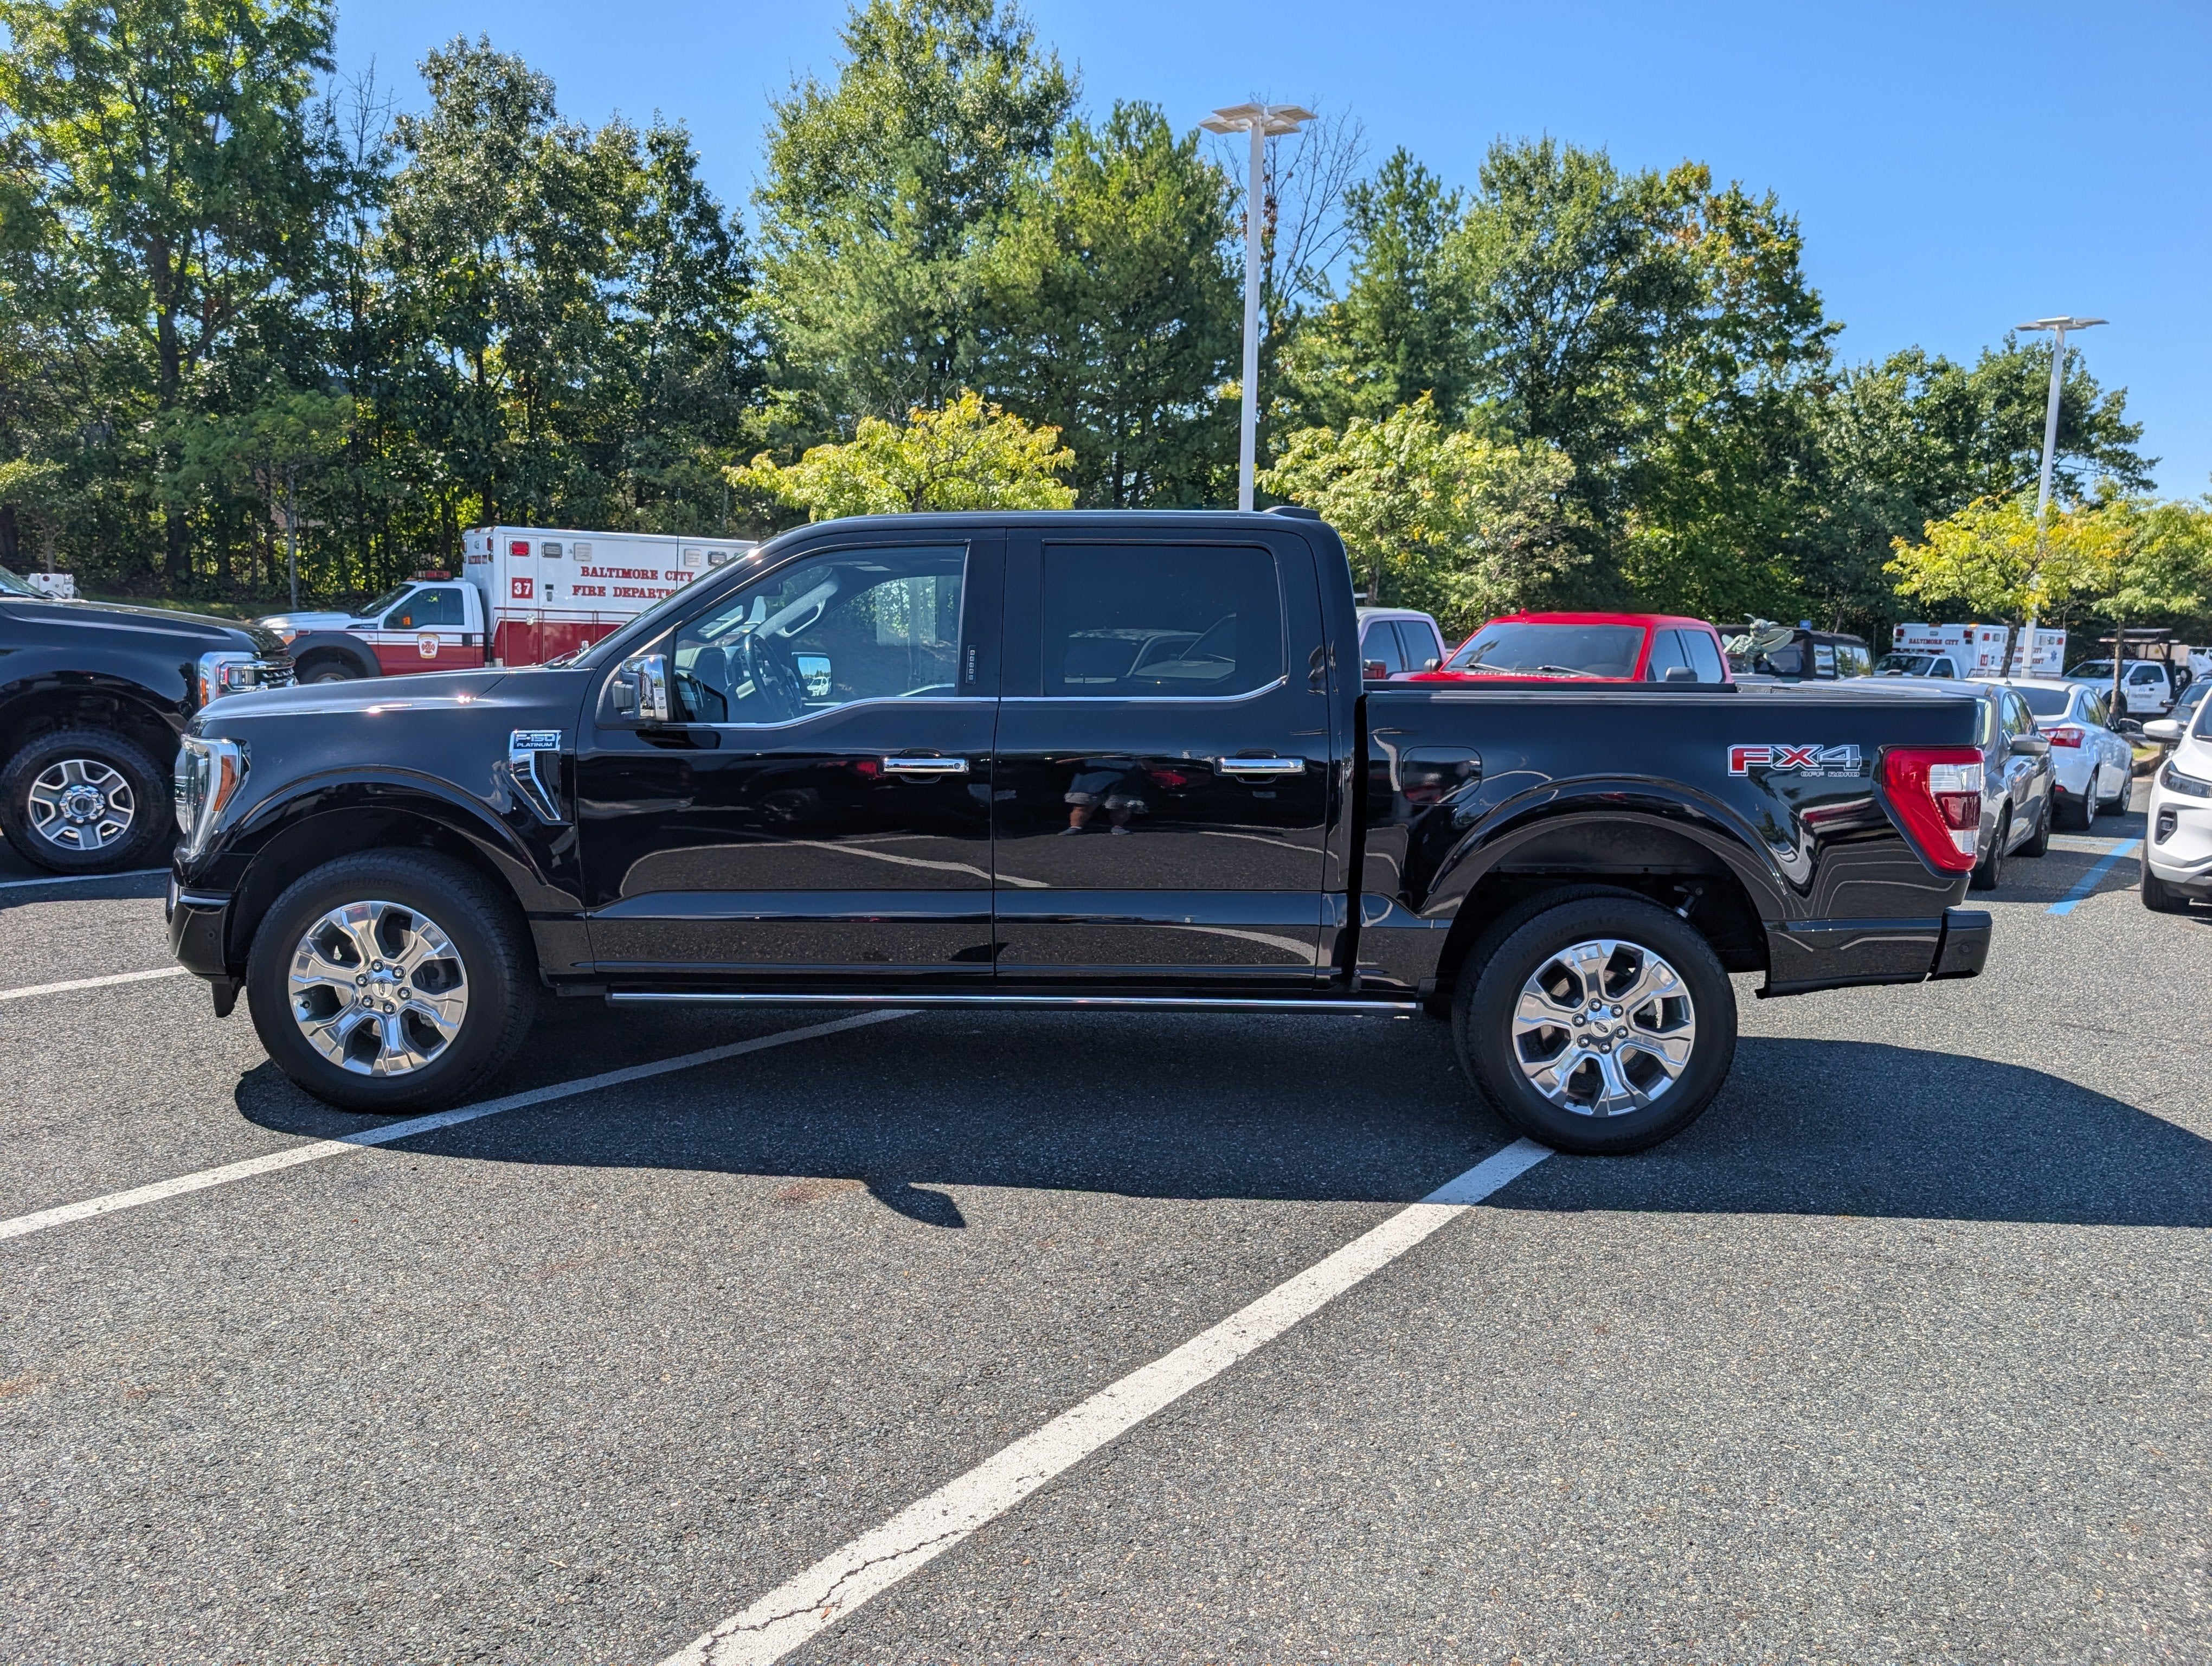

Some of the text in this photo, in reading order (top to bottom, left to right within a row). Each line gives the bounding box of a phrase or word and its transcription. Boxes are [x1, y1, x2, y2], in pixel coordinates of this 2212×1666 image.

[581, 566, 695, 582] BALTIMORE CITY
[515, 582, 531, 595] 37
[572, 585, 606, 597] FIRE
[516, 734, 556, 743] F-150
[1728, 744, 1862, 777] FX4
